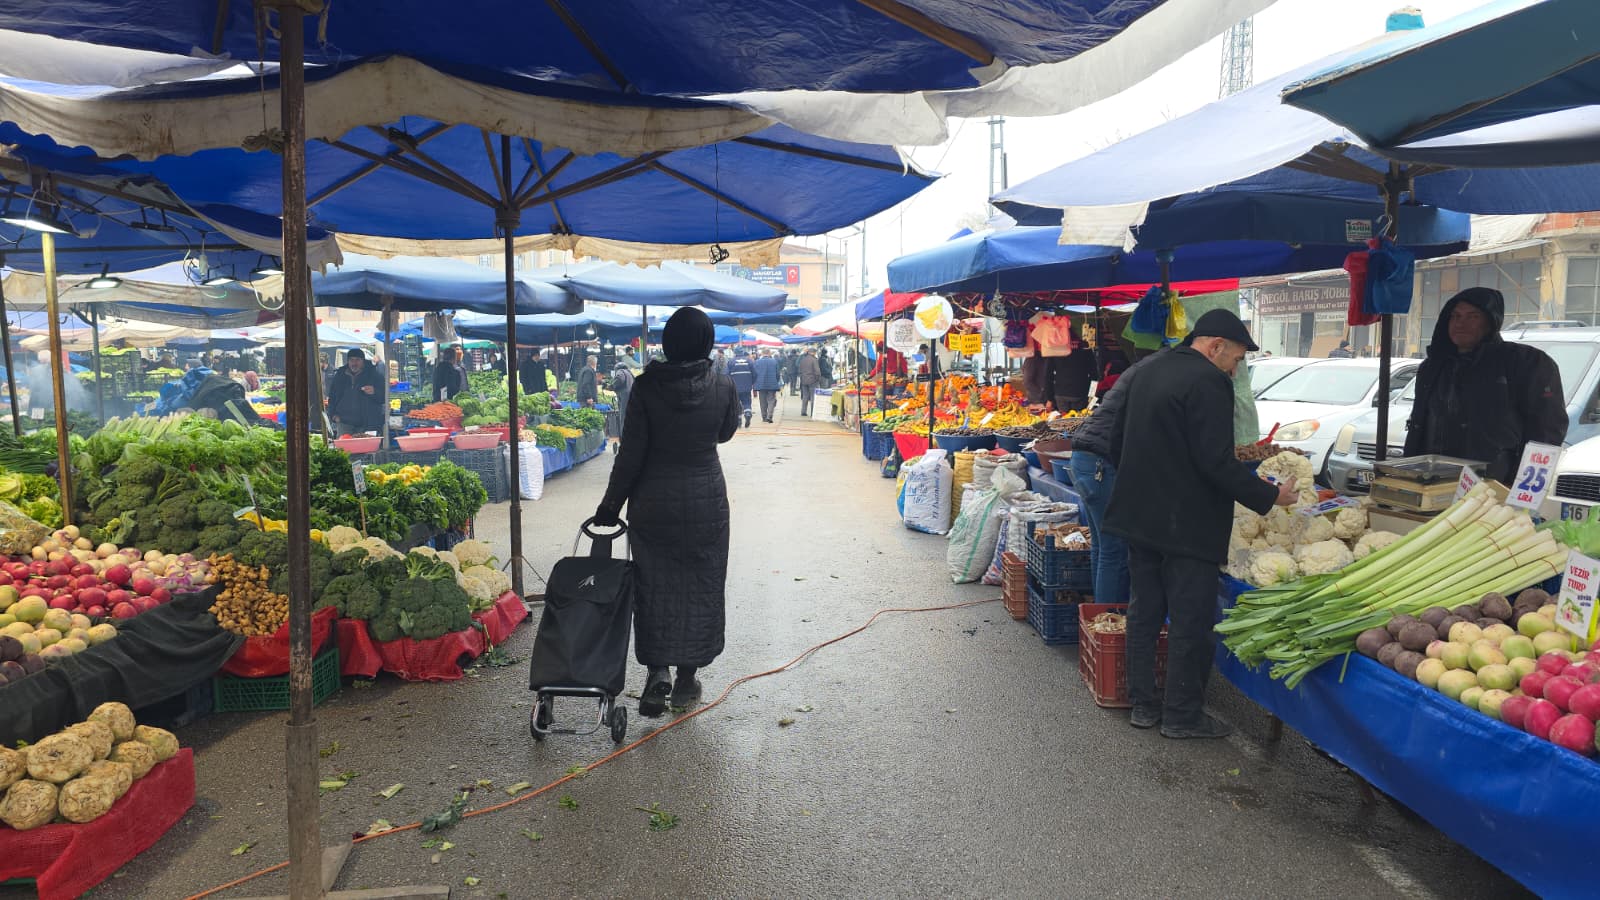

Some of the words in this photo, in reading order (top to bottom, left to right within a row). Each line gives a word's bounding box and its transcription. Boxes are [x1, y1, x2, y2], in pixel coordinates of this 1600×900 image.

[1363, 472, 1375, 482] 16
[1517, 465, 1549, 493] 25
[1569, 505, 1583, 521] 16
[1570, 565, 1590, 580] VEZİR
[1567, 578, 1587, 592] TURP
